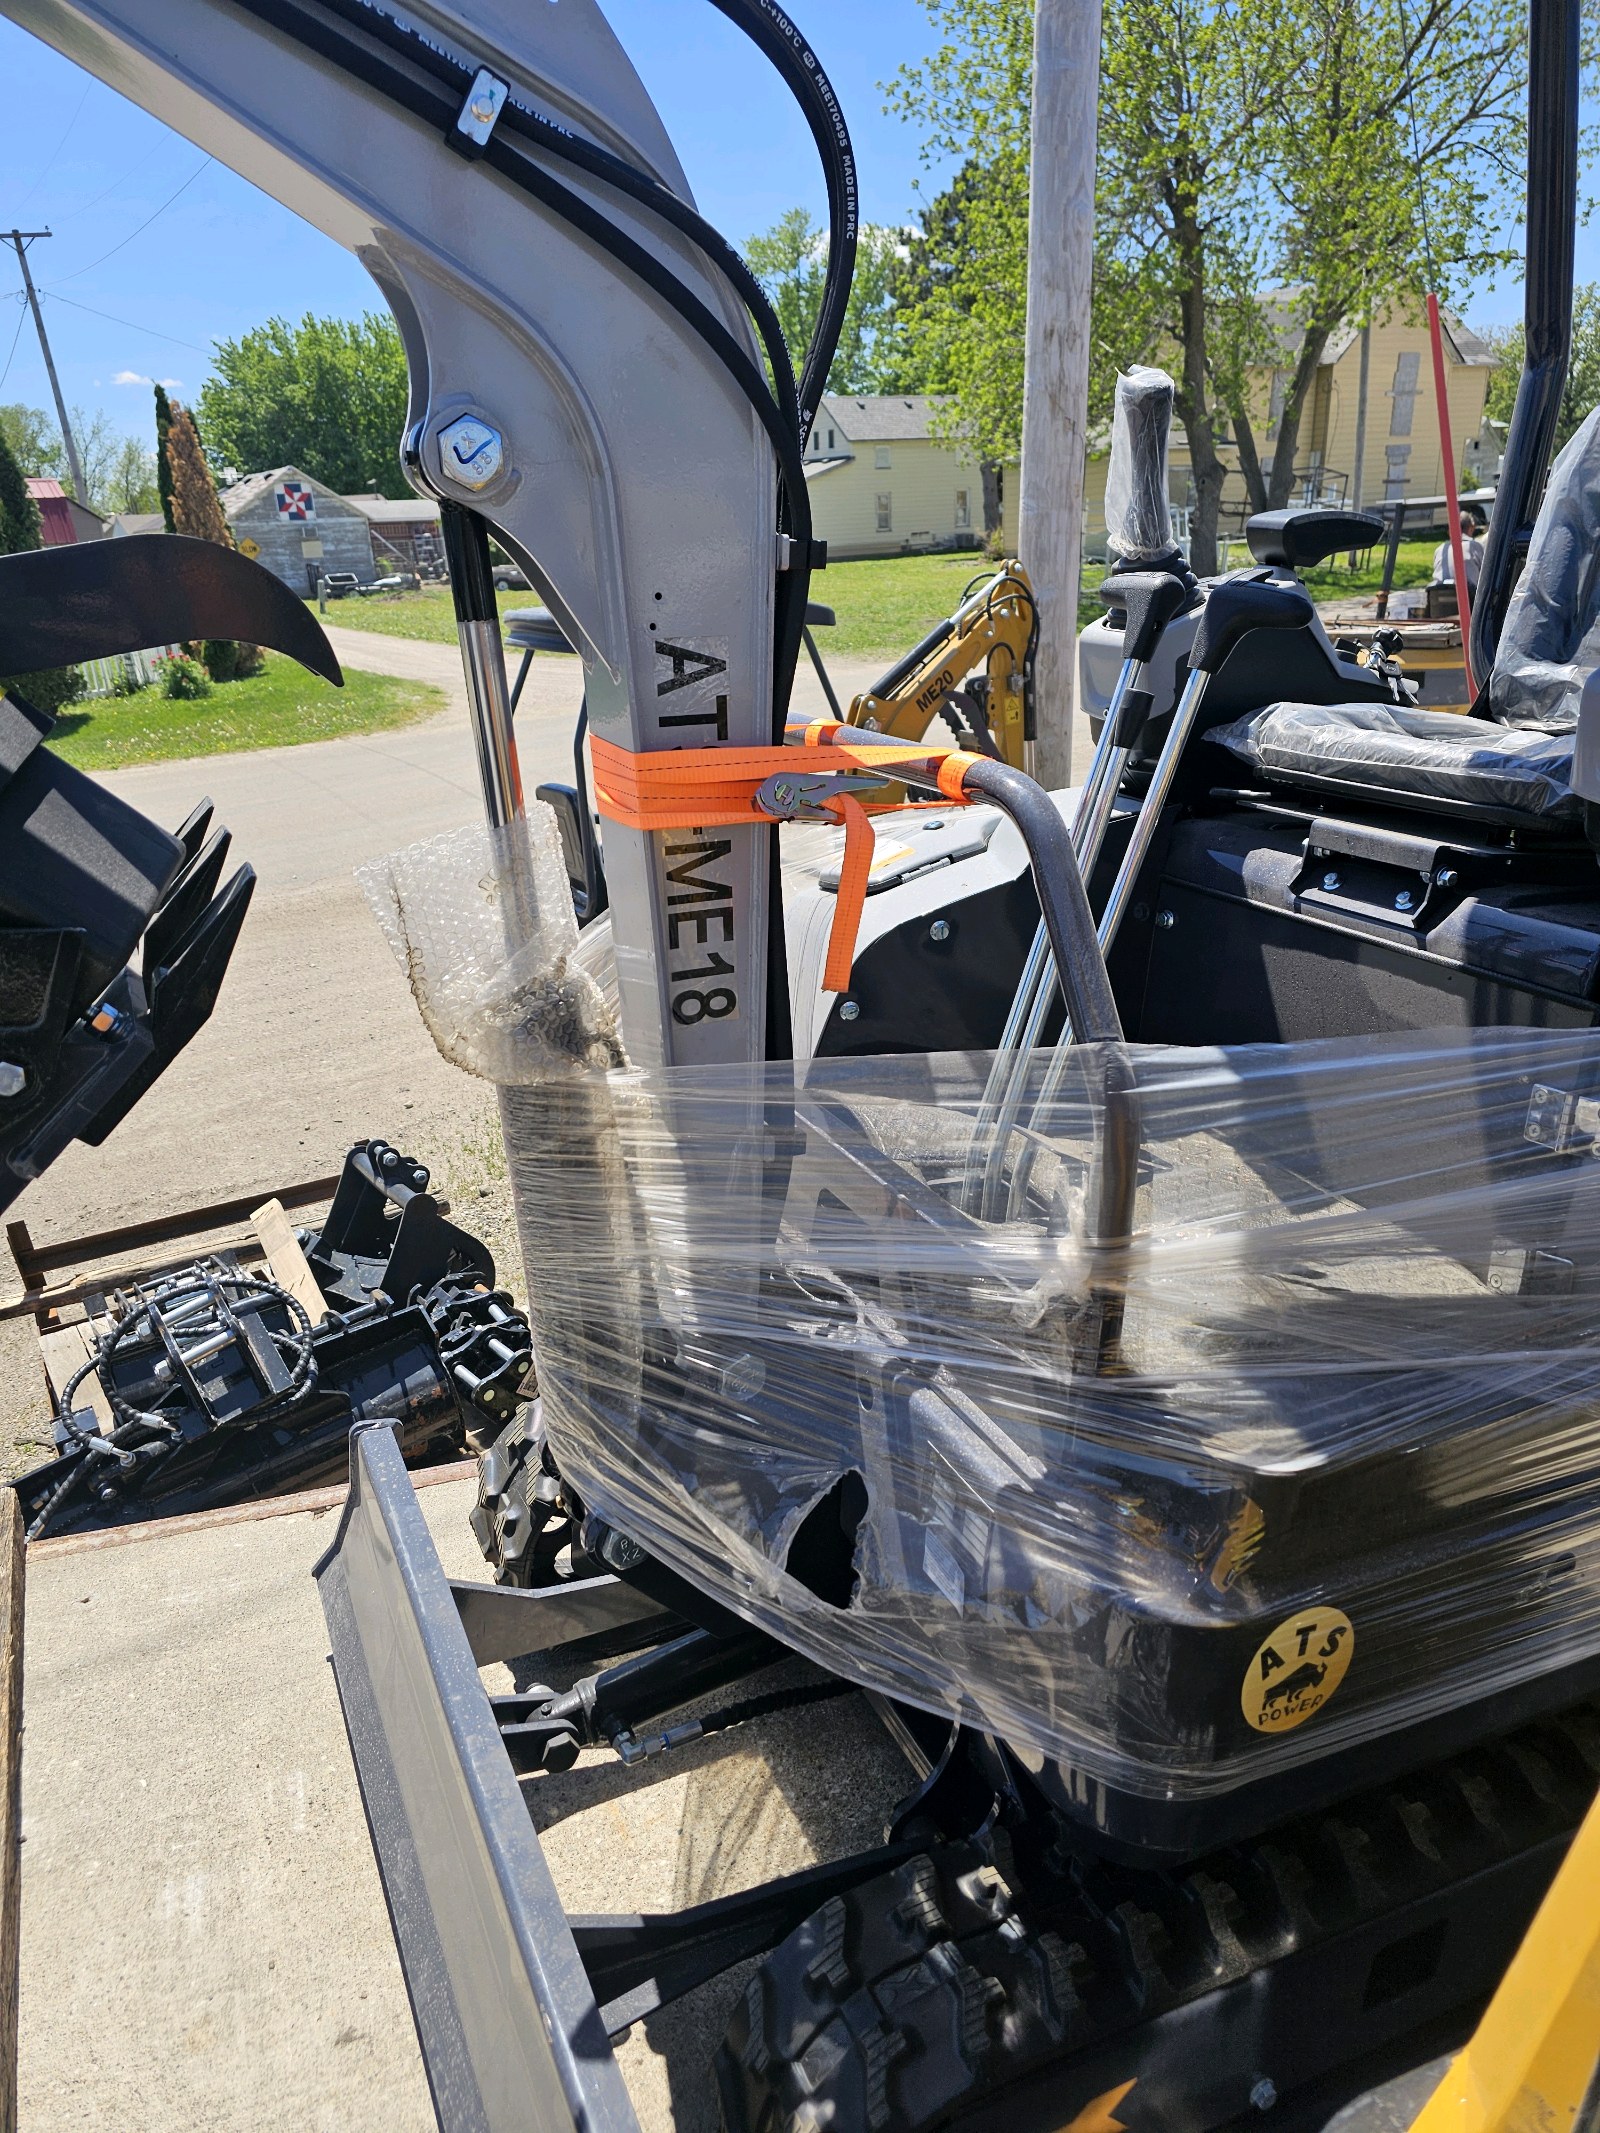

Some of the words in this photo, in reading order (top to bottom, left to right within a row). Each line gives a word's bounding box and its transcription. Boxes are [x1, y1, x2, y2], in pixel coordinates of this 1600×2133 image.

[814, 73, 847, 148] MEE170495
[843, 155, 855, 194] MADE
[847, 197, 855, 211] IN
[846, 214, 855, 240] PRC
[915, 669, 954, 713] ME20
[1260, 1624, 1347, 1681] ATS
[1258, 1693, 1324, 1726] POWER
